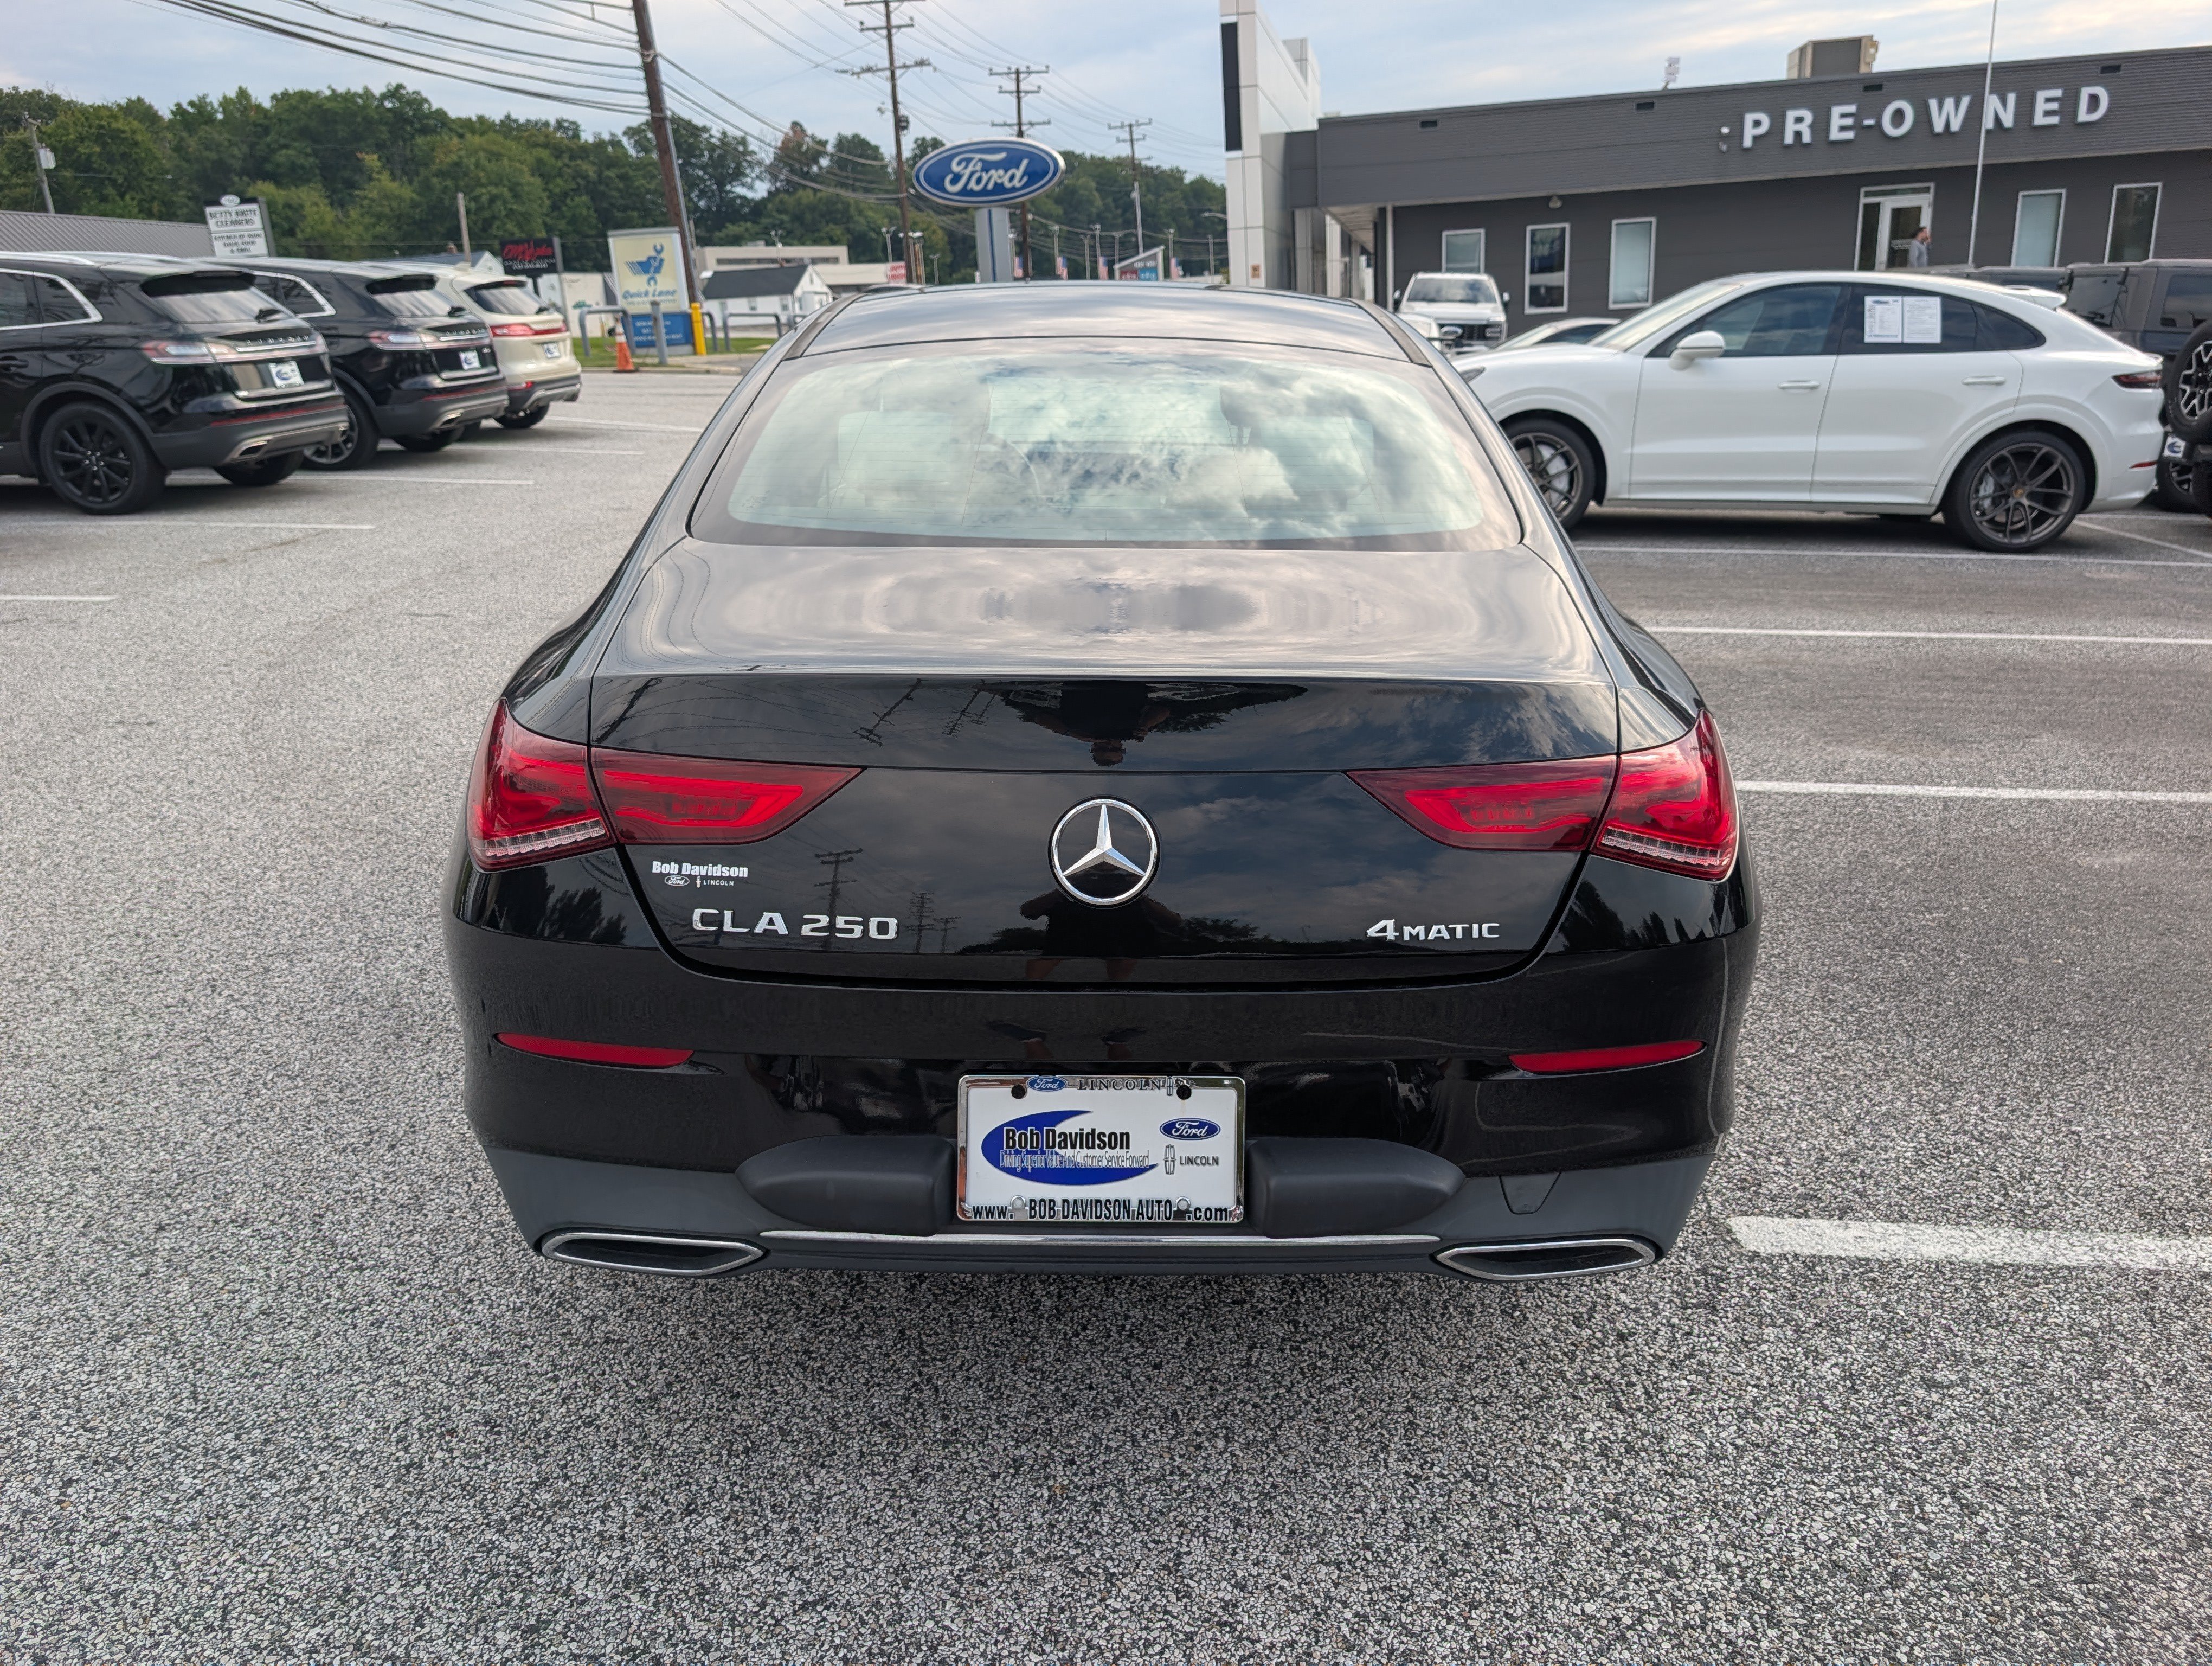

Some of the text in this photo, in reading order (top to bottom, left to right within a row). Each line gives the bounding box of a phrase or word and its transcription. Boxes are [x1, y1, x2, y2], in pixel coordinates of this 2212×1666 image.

[1742, 86, 2110, 149] PRE-OWNED
[944, 151, 1030, 193] Ford
[216, 218, 256, 228] CLEANERS
[622, 287, 678, 300] Quick Lane
[652, 861, 749, 877] Bob Davidson
[668, 875, 686, 885] Ford
[692, 908, 898, 940] CLA 250
[1366, 919, 1500, 941] 4MATIC
[1033, 1077, 1162, 1091] Ford LINCOLN
[1004, 1126, 1130, 1150] Bob Davidson
[1171, 1120, 1209, 1137] Ford
[1000, 1149, 1149, 1173] Driving Superior Value And Customer Service Forward
[1179, 1155, 1220, 1166] LINCOLN
[972, 1197, 1229, 1221] www. BOB DAVIDSON AUTO .com
